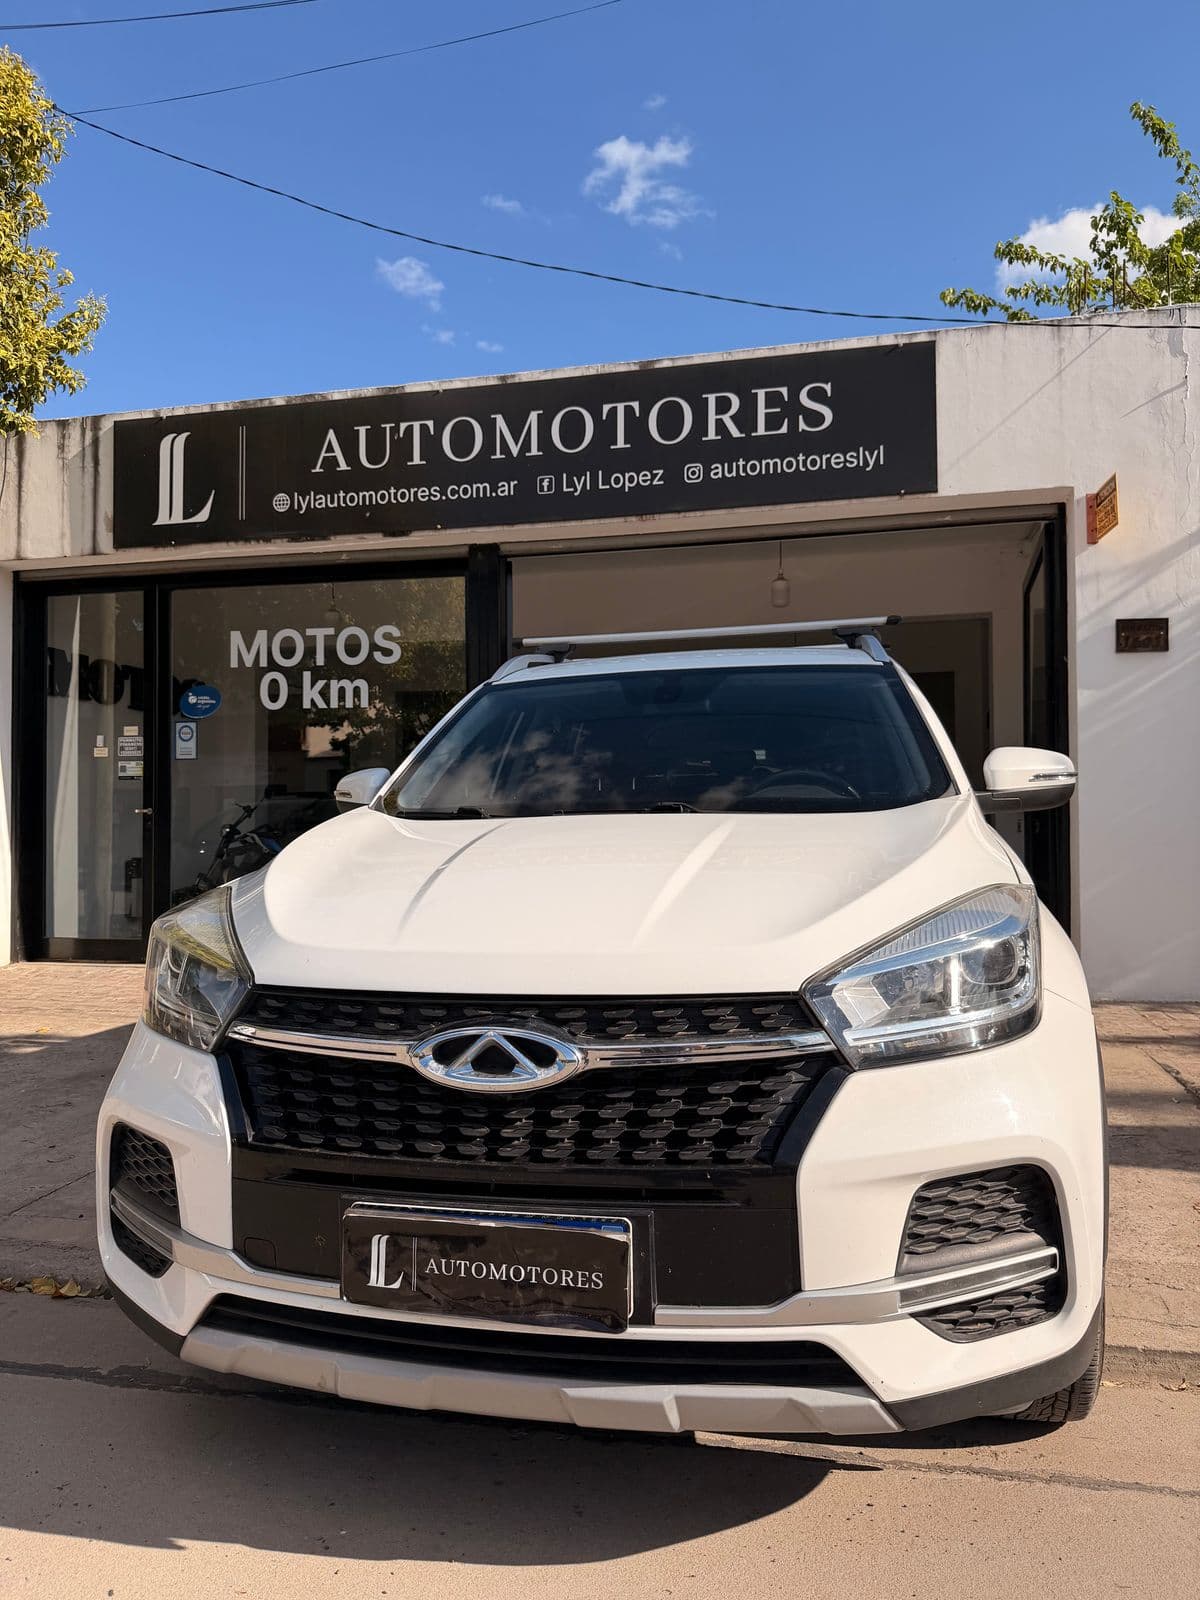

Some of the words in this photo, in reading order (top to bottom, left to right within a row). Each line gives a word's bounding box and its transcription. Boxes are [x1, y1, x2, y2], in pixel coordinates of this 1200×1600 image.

[311, 382, 834, 474] AUTOMOTORES
[709, 445, 885, 479] automotoreslyl
[293, 477, 518, 514] lylautomotores.com.ar
[562, 470, 591, 496] Lyl
[598, 467, 664, 493] Lopez
[229, 624, 402, 669] MOTOS
[259, 671, 289, 711] 0
[302, 670, 369, 710] km
[424, 1258, 604, 1290] AUTOMOTORES
